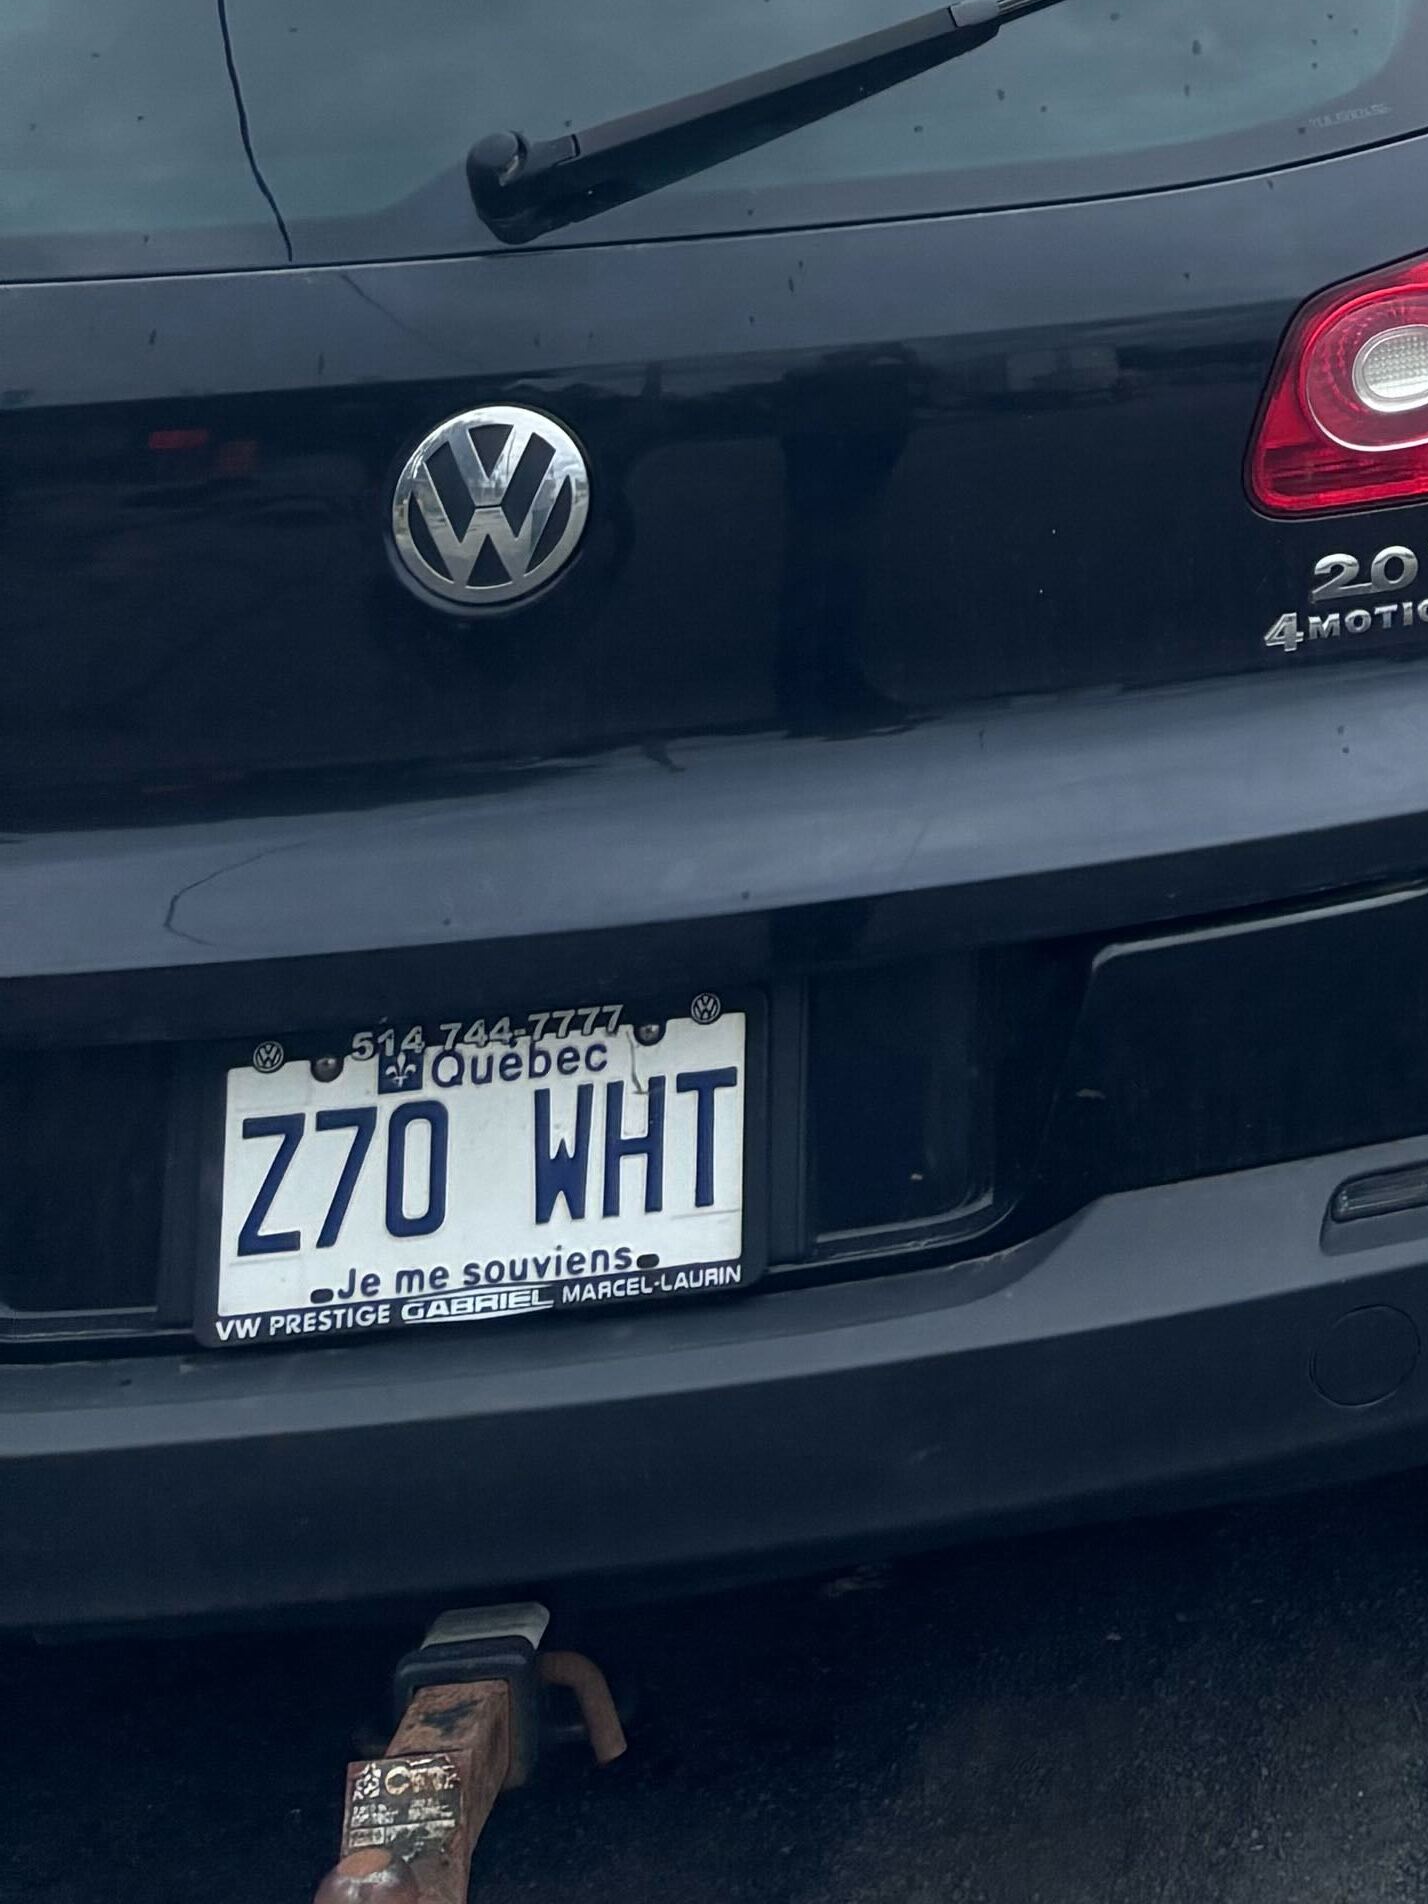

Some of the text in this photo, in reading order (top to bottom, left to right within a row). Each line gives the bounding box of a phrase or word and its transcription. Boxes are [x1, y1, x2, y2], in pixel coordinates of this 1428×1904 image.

[352, 1004, 624, 1061] 514 744-7777
[237, 1066, 737, 1257] Z70 WHT
[216, 1264, 742, 1342] VW PRESTIGE GABRIEL MARCEL-LAURIN
[337, 1245, 633, 1299] Je me souviens
